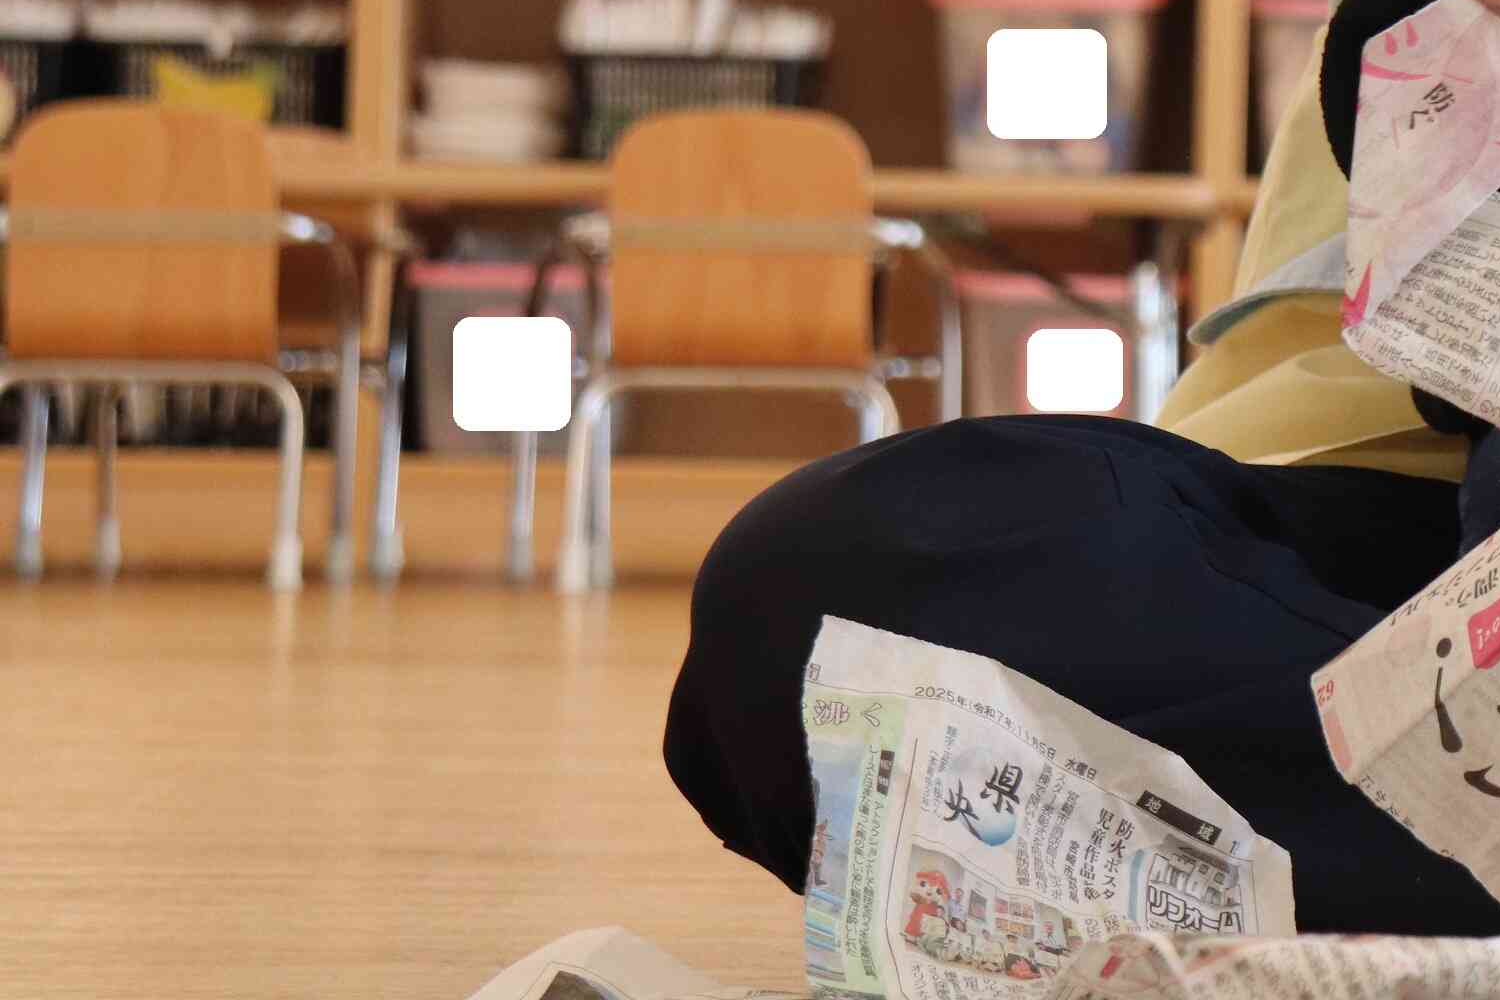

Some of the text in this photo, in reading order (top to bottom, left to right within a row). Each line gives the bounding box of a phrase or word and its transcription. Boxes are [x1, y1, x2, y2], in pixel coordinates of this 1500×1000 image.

[944, 762, 1024, 823] 県央
[1149, 886, 1243, 934] リフォーム
